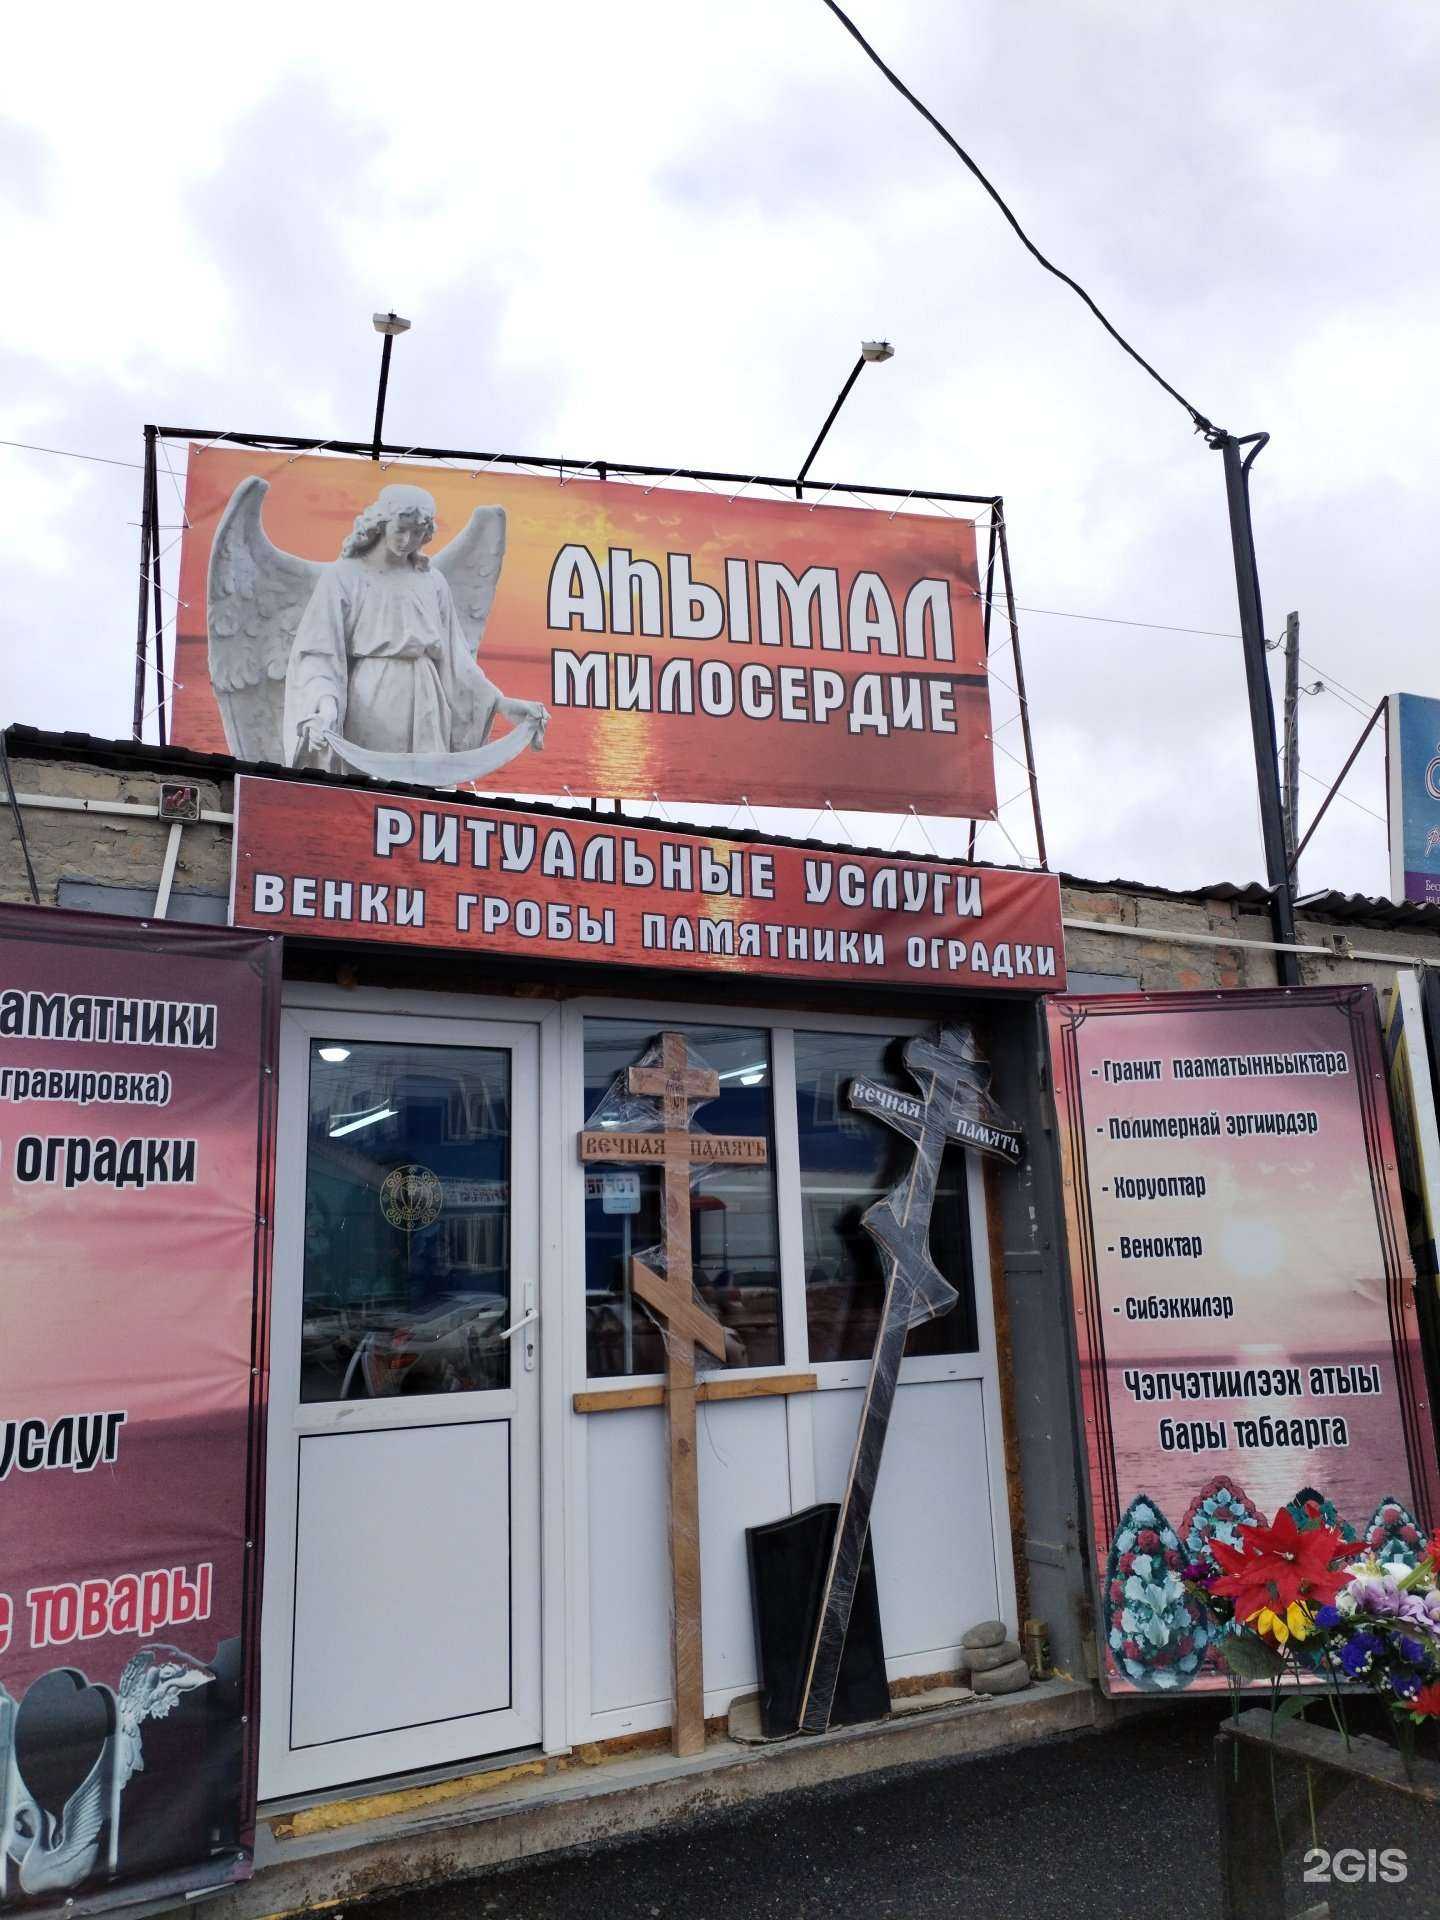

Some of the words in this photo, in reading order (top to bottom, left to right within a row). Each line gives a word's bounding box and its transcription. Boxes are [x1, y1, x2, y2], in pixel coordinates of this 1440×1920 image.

[551, 648, 958, 736] МИЛОСЕРДИЕ
[374, 805, 775, 899] РИТУАЛЬНЫЕ
[804, 857, 983, 918] УСЛУГИ
[253, 873, 426, 928] ВЕНКИ
[456, 893, 616, 945] ГРОБЫ
[642, 912, 885, 966] ПАМЯТНИКИ
[907, 935, 1056, 979] ОГРАДКИ
[0, 1067, 172, 1106] гравировка)
[1103, 1059, 1162, 1083] Гранит
[1172, 1051, 1348, 1079] пааматынньыктара
[853, 1082, 921, 1118] ВЕЧНАЯ
[956, 1119, 1020, 1154] ПАМЯТЬ
[1108, 1112, 1220, 1139] Полимернай
[1225, 1111, 1318, 1137] эргиирдэр
[16, 1134, 198, 1190] оградки
[690, 1138, 766, 1157] ПАМЯТЬ
[1113, 1174, 1206, 1200] Хоруоптар
[1120, 1236, 1202, 1259] Веноктар
[1125, 1295, 1234, 1320] Сибэккилэр
[1124, 1367, 1301, 1401] Чэпчэтиилээх
[1309, 1365, 1381, 1396] атыы
[1159, 1417, 1227, 1453] бары
[1232, 1414, 1348, 1449] табаарга
[27, 1563, 213, 1648] товары
